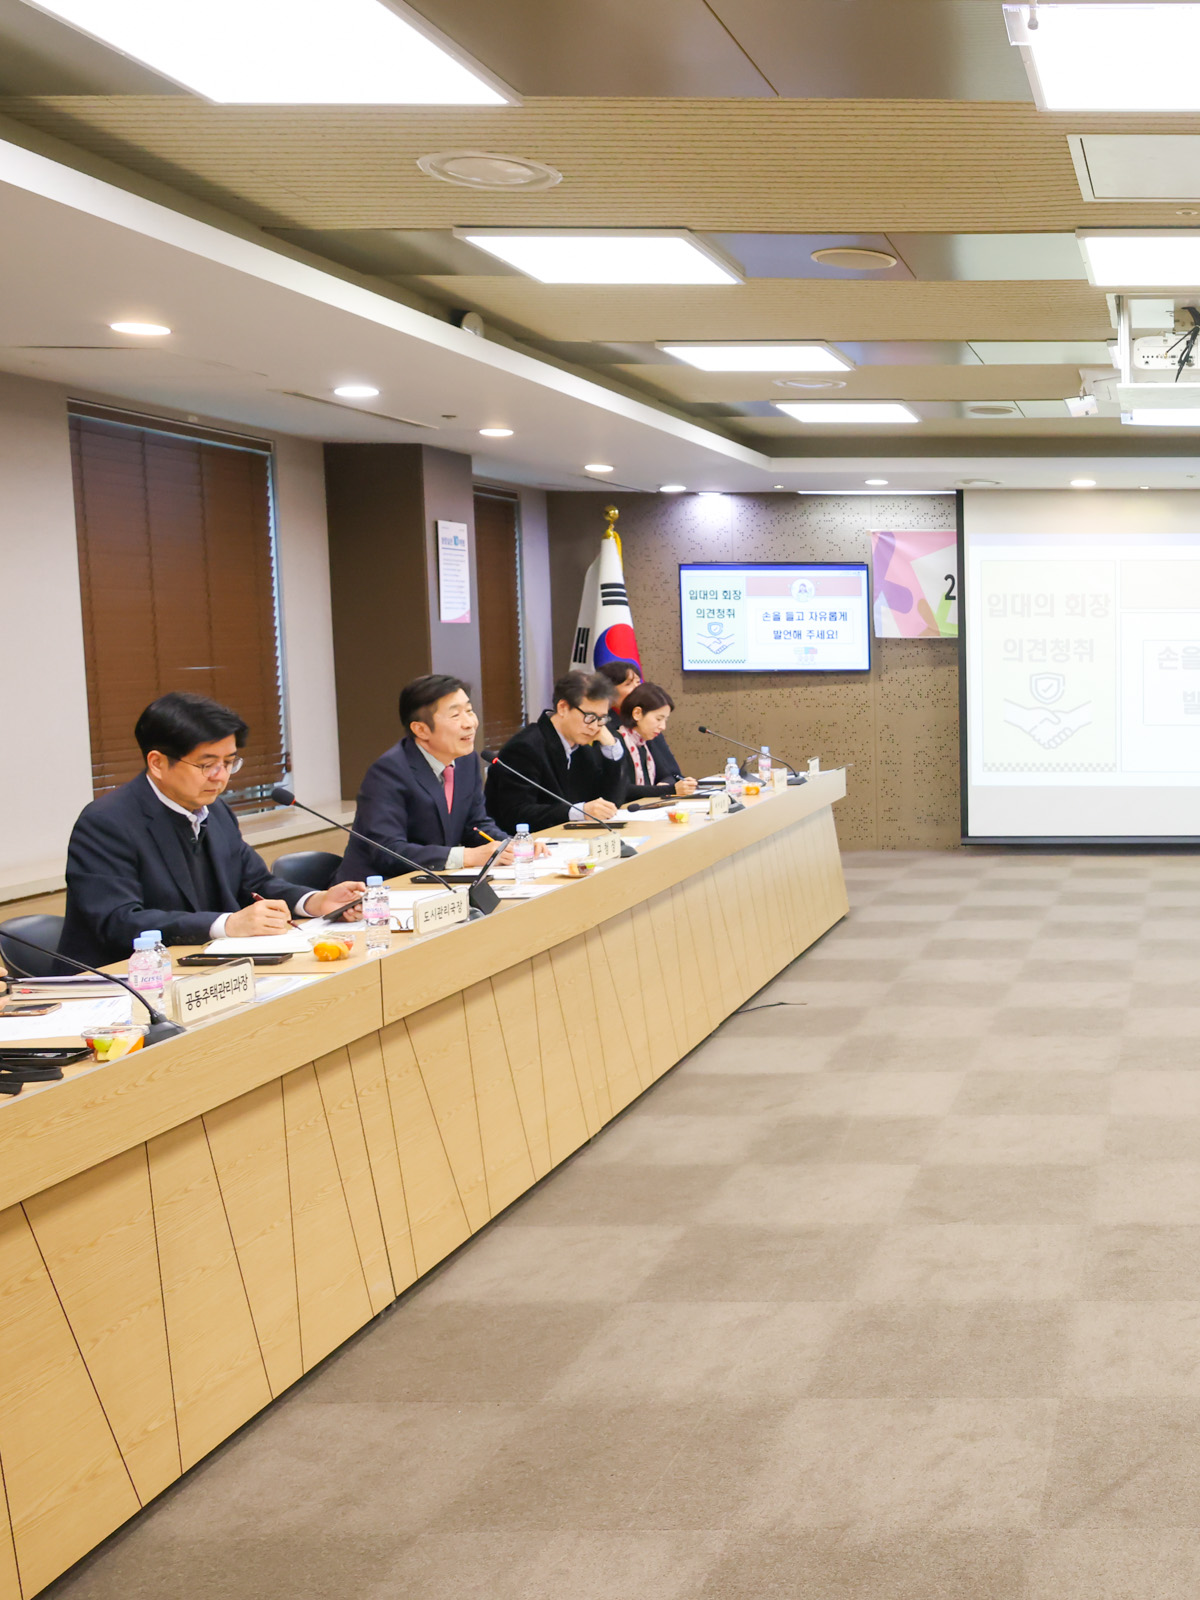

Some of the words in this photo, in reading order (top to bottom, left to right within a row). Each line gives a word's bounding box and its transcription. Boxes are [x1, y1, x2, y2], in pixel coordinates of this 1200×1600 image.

[688, 589, 719, 601] 입대의
[722, 589, 742, 601] 회장
[695, 607, 736, 619] 의견청취
[987, 593, 1056, 619] 입대의
[1065, 592, 1112, 619] 회장
[761, 611, 781, 622] 손을
[785, 611, 805, 622] 들고
[808, 610, 848, 622] 자유롭게
[772, 629, 803, 640] 발언해
[806, 628, 839, 640] 주세요!
[1003, 637, 1096, 664] 의견청취
[423, 900, 463, 923] 도시관리국장
[185, 973, 249, 1011] 공동주택관리과장
